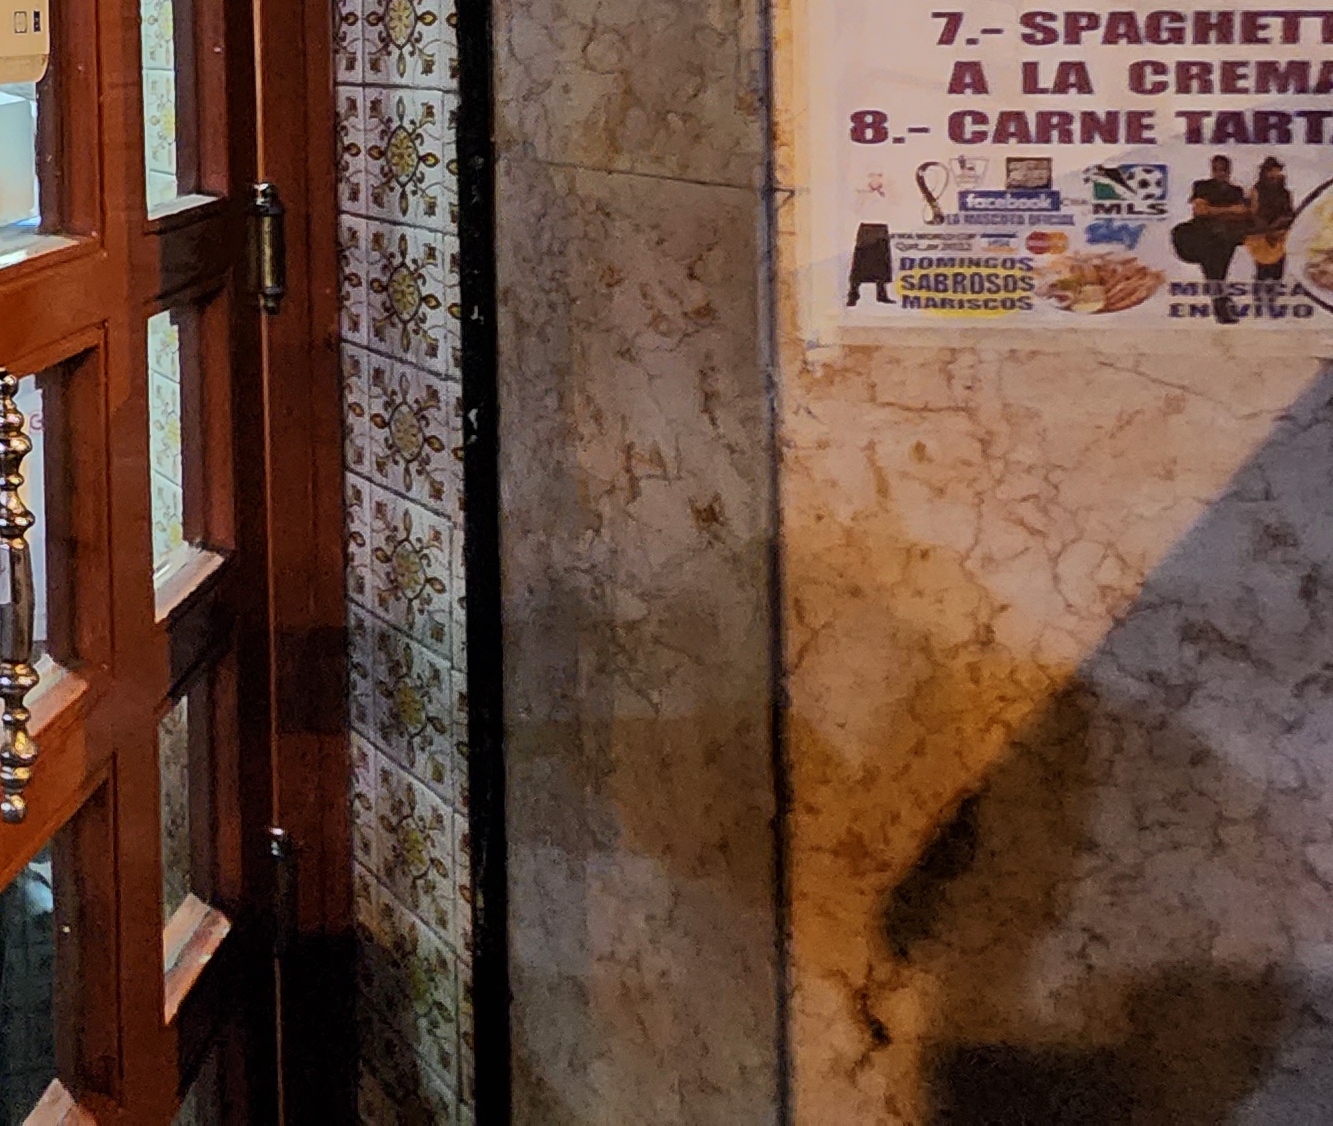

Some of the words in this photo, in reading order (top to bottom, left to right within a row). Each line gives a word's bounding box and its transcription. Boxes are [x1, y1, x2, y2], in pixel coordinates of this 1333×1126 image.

[931, 11, 1003, 46] 7.-
[948, 59, 989, 95] A
[1021, 59, 1095, 95] LA
[849, 110, 930, 145] 8.-
[947, 110, 1158, 145] CARNE
[1174, 110, 1333, 145] TART
[966, 192, 1053, 209] facebook
[1092, 203, 1169, 216] MLS
[899, 256, 1034, 272] DOMINGOS
[900, 271, 1035, 295] SABROSOS
[901, 294, 1034, 311] MARISCOS
[1169, 302, 1210, 318] EN
